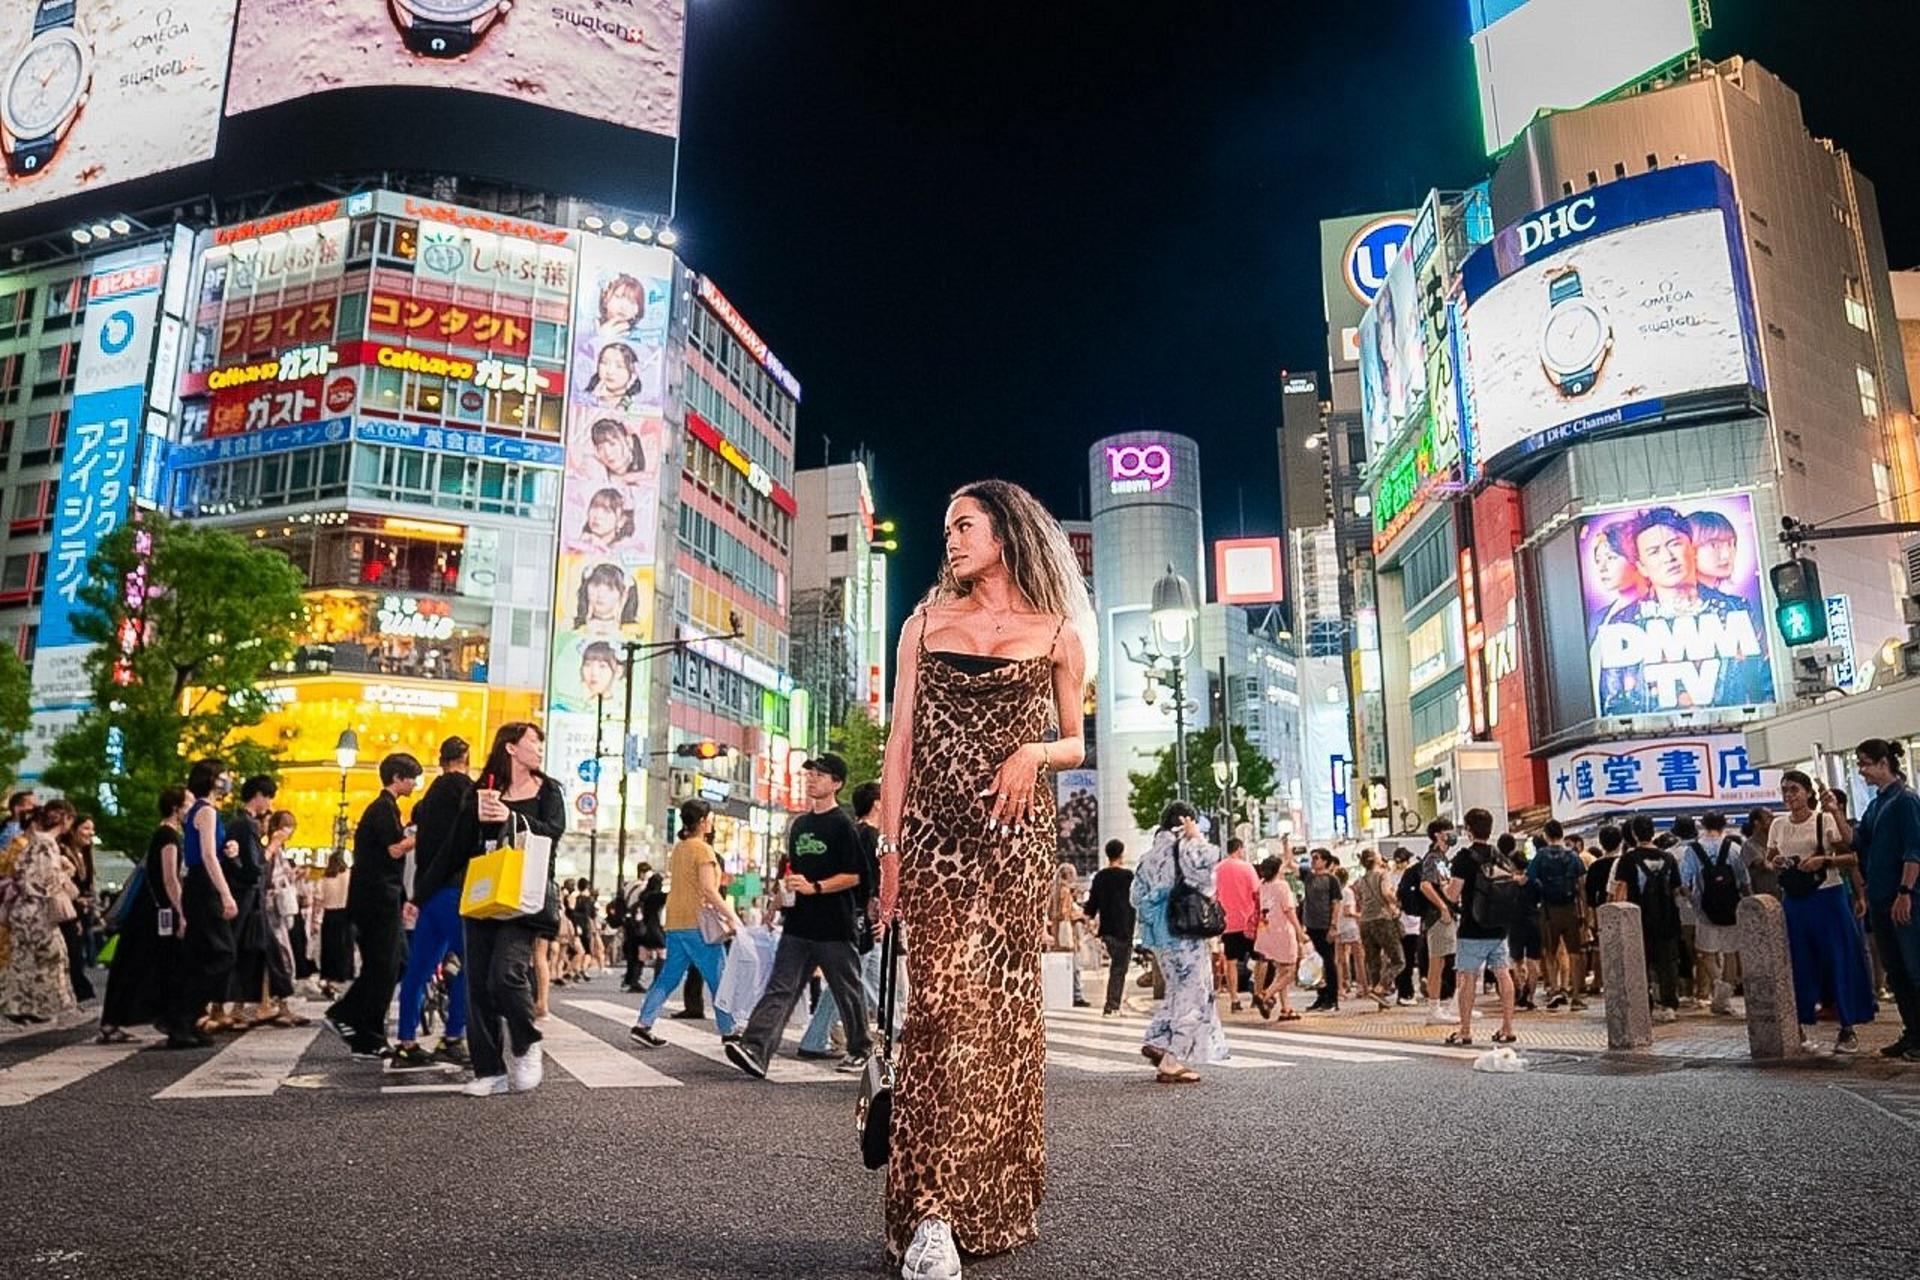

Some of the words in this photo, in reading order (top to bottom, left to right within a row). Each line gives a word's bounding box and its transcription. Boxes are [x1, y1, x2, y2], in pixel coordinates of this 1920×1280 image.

[133, 22, 190, 49] OMEGA
[551, 7, 628, 41] swatch
[1517, 196, 1597, 256] DHC
[473, 247, 567, 287] しゃぶ葉
[1641, 290, 1695, 308] OMEGA
[371, 296, 527, 346] コンタクト
[474, 359, 550, 396] ガスト
[245, 391, 316, 431] ガスト
[1547, 422, 1573, 443] DHC
[1573, 409, 1623, 433] Channel
[1106, 445, 1171, 490] 109
[55, 422, 104, 605] アイシティ
[1595, 610, 1761, 669] DMM
[1645, 658, 1722, 709] TV
[1555, 746, 1762, 803] 大盛堂書店
